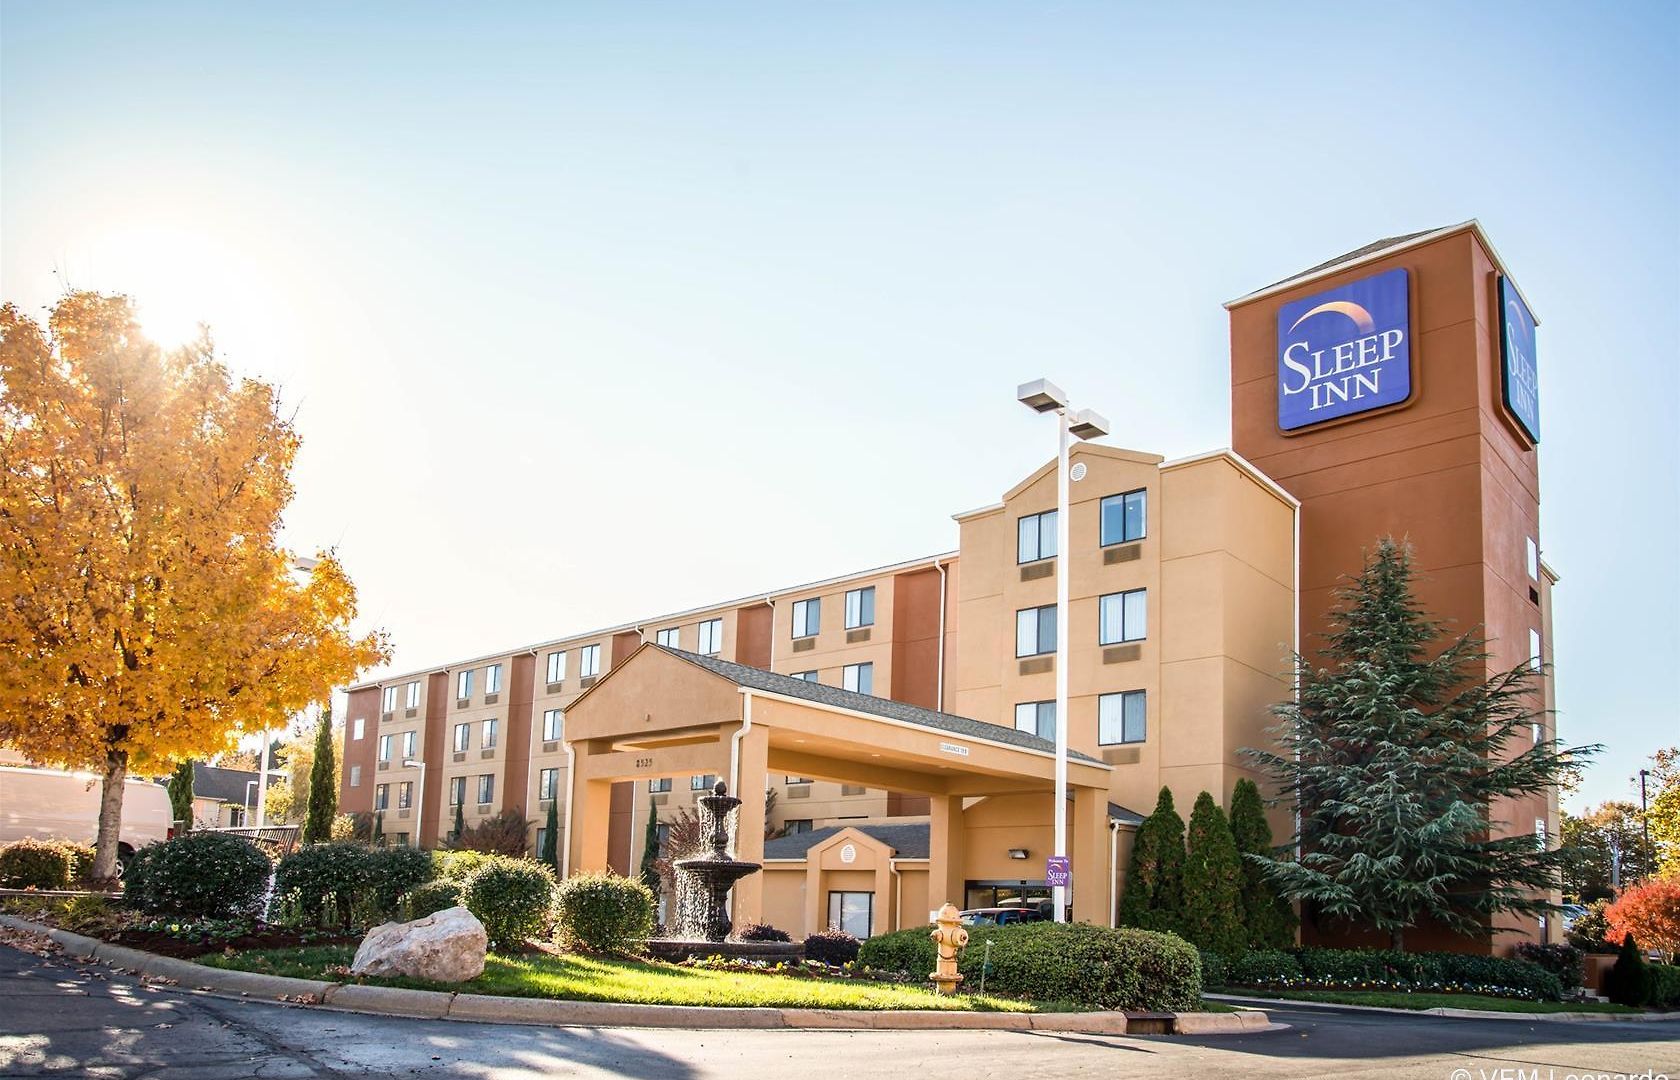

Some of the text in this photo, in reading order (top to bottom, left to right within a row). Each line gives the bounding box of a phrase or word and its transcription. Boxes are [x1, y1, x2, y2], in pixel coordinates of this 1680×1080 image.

[1283, 328, 1403, 395] SLEEP
[1309, 368, 1382, 411] INN
[1507, 322, 1537, 397] SLEEP
